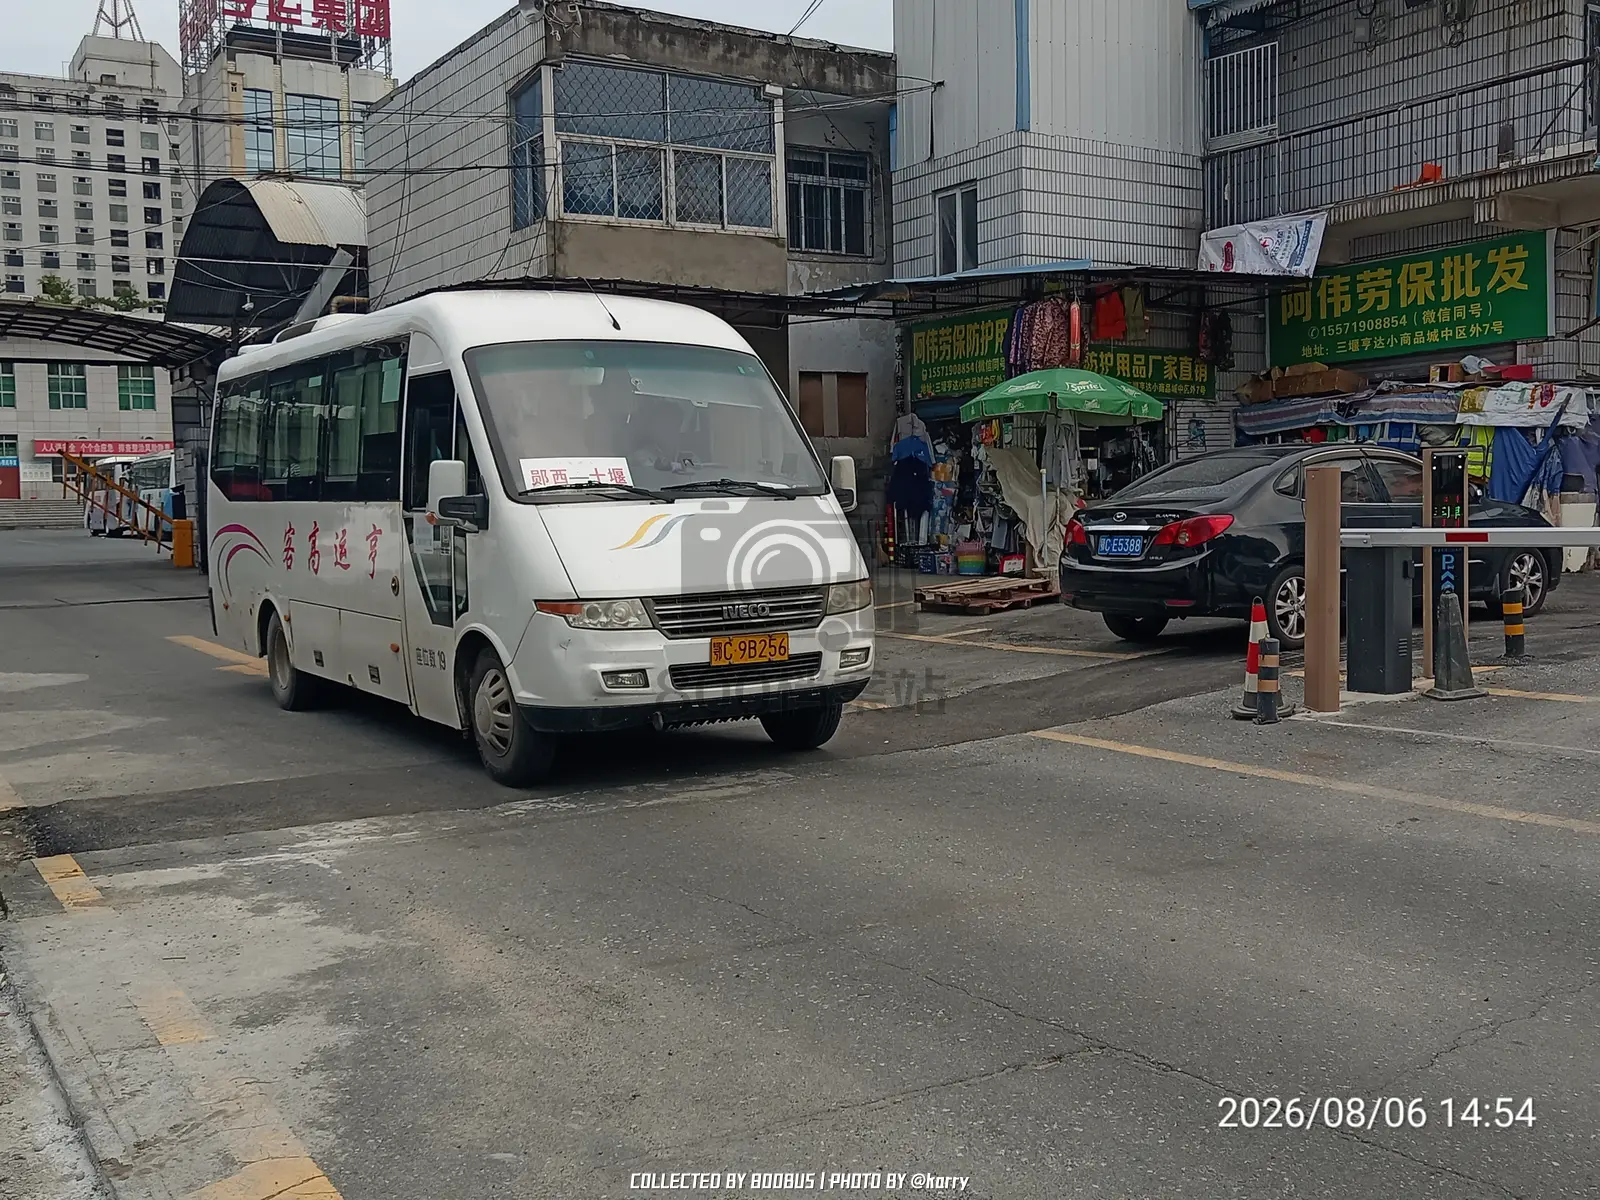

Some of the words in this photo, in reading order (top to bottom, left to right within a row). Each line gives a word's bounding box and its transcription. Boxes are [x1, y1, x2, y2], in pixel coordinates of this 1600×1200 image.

[1281, 244, 1530, 327] 阿伟劳保批发
[913, 318, 1008, 366] 阿伟劳保防护用
[1070, 382, 1104, 393] Sprite
[722, 603, 771, 620] IVECO
[437, 650, 447, 671] 19
